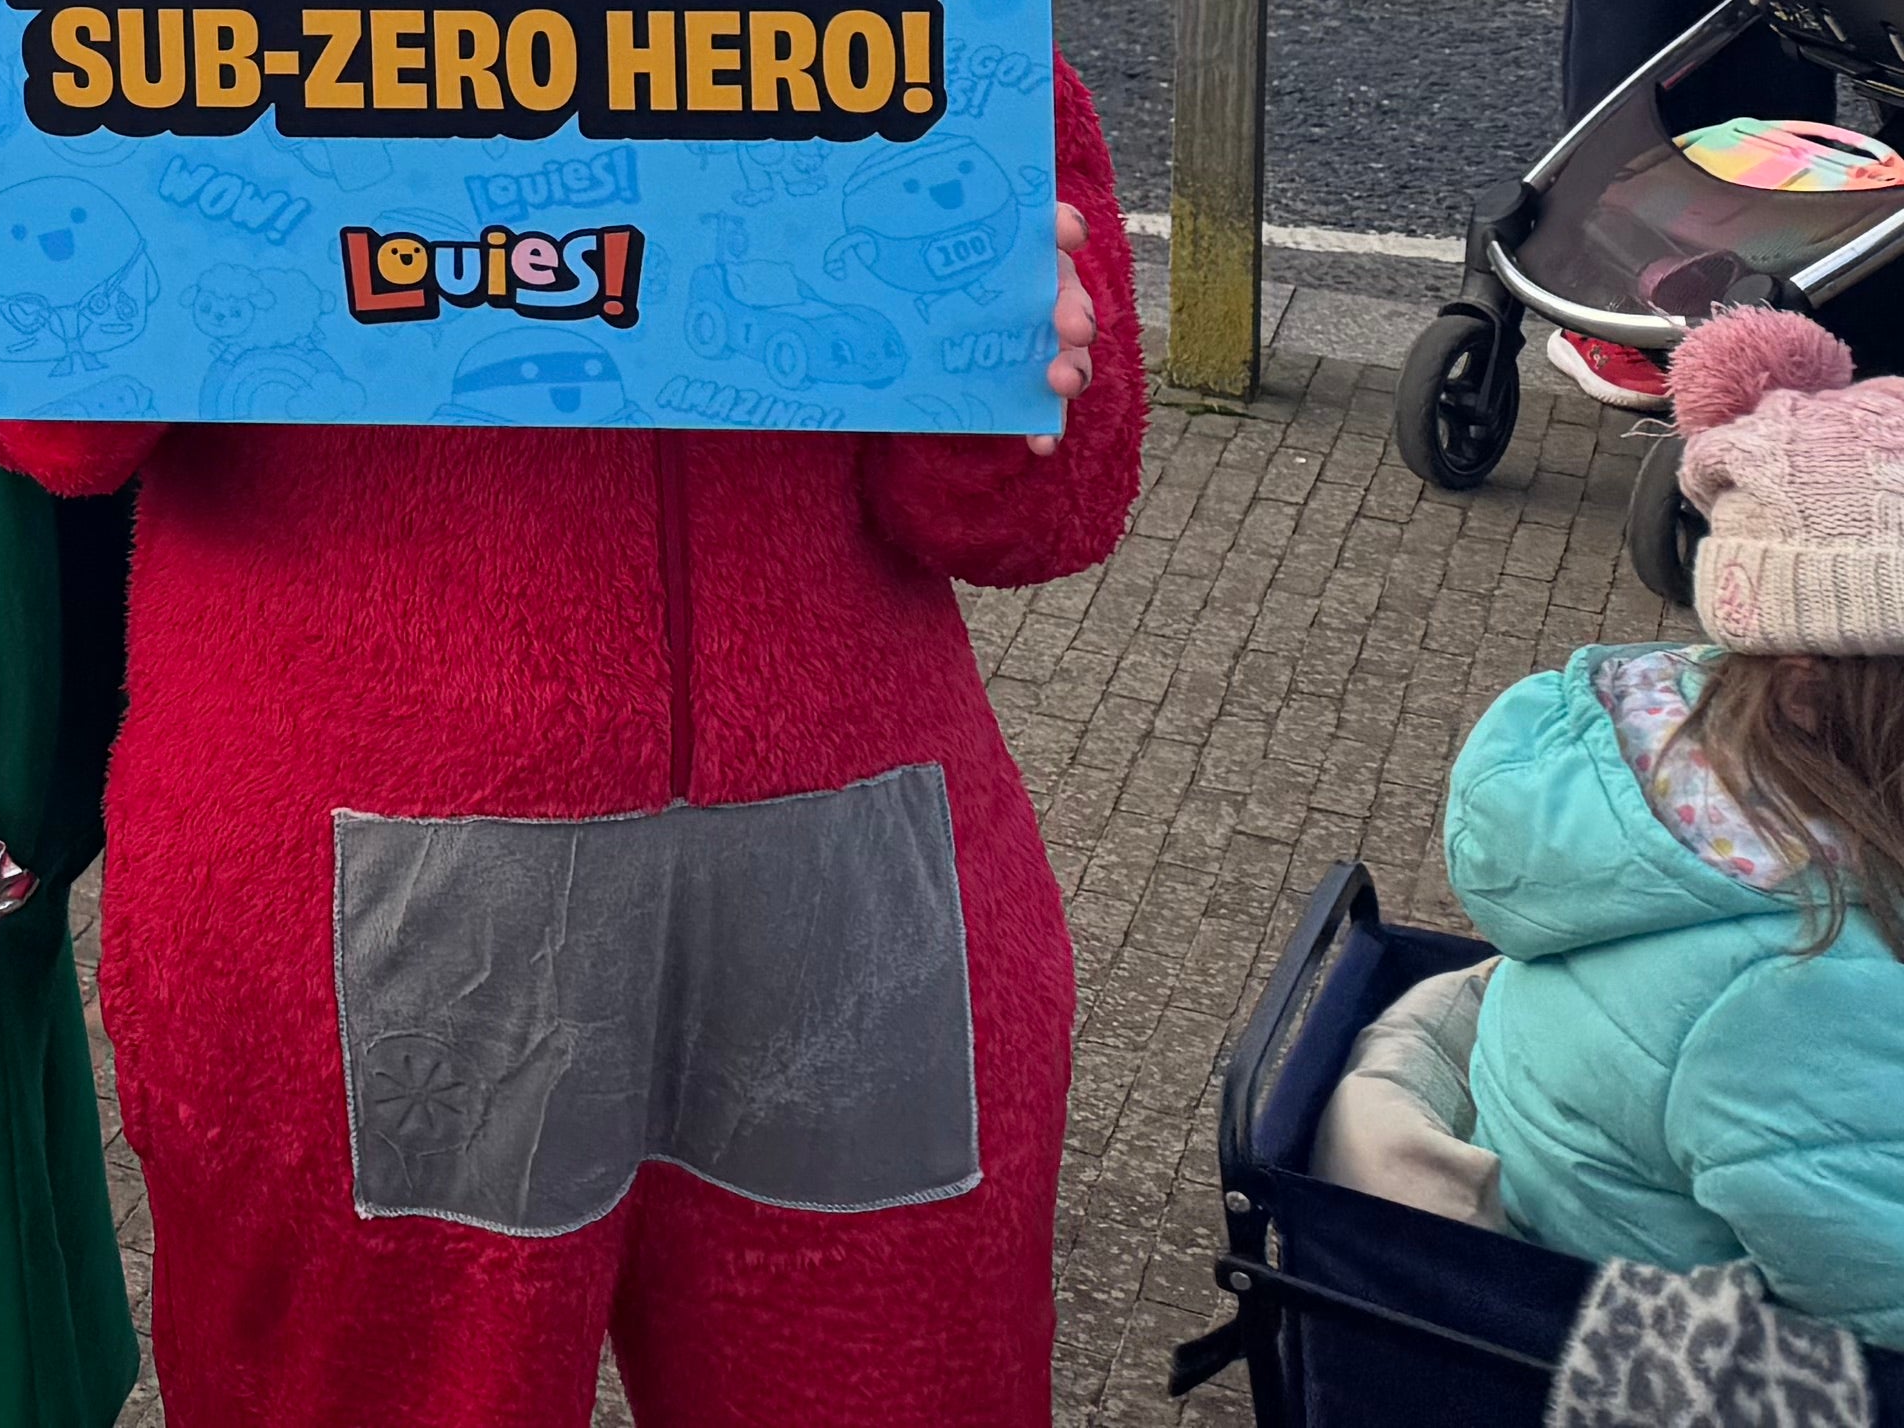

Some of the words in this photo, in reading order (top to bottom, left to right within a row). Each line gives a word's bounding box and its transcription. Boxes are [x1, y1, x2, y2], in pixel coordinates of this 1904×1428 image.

[50, 7, 578, 110] SUB-ZERO
[605, 8, 934, 114] HERO!
[159, 155, 315, 244] WOW!
[346, 230, 630, 316] Louies!
[940, 235, 989, 270] 100
